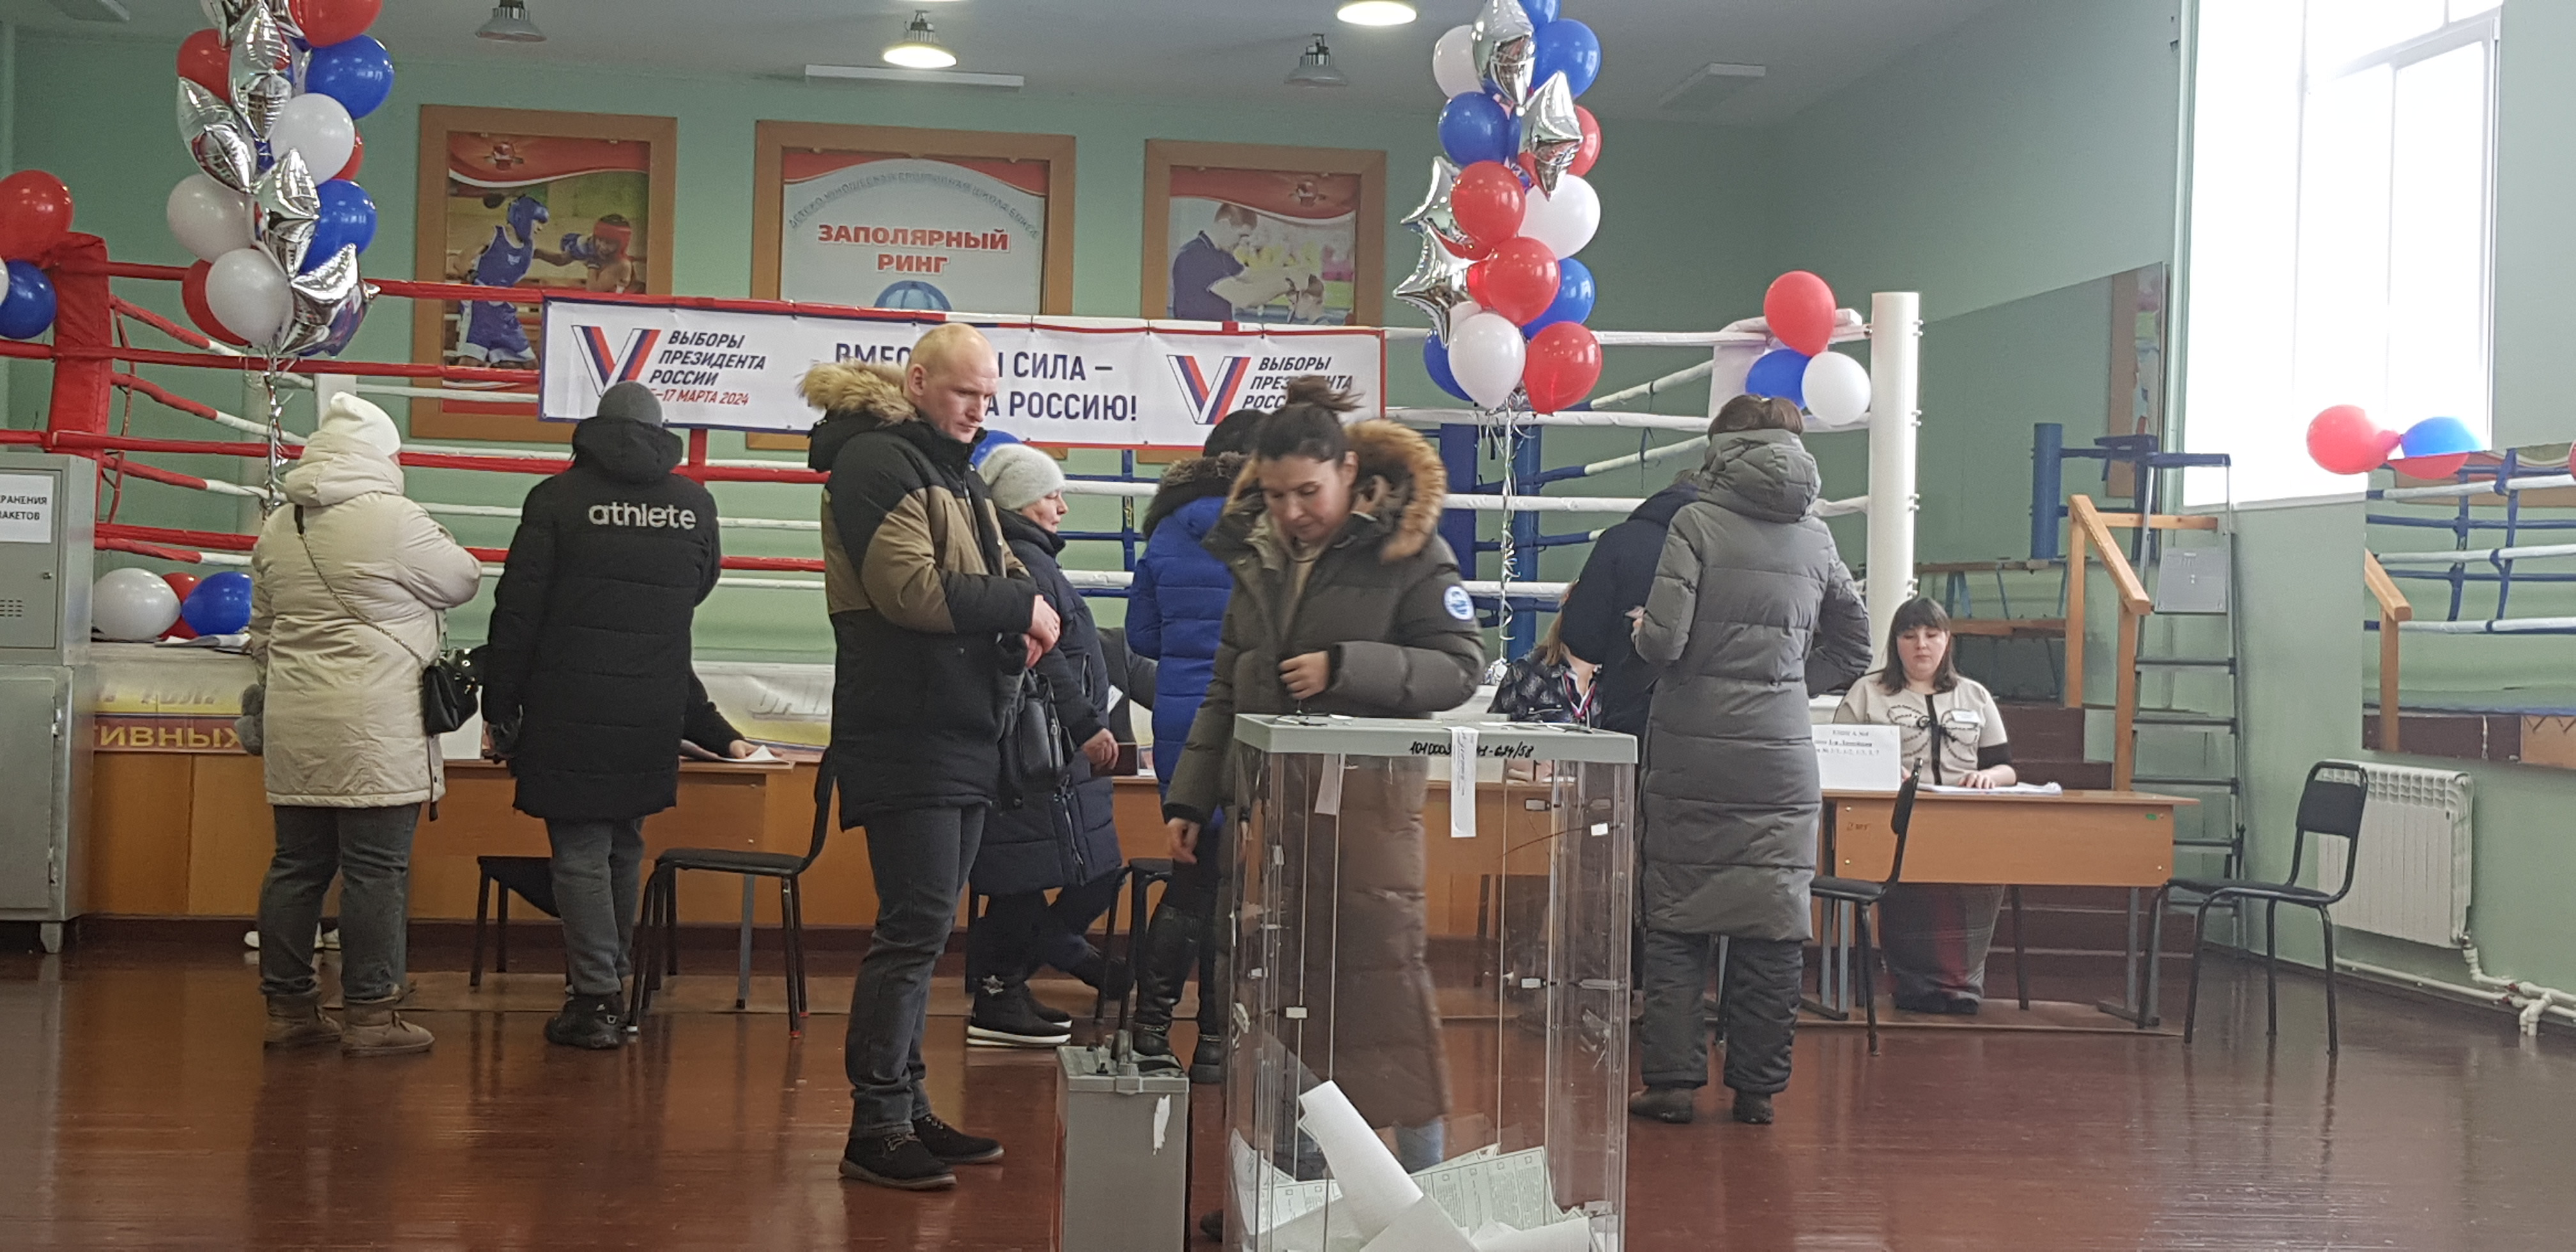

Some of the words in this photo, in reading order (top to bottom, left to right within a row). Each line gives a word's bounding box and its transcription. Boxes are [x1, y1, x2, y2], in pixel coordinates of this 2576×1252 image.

[818, 224, 1009, 250] ЗАПОЛЯРНЫЙ
[877, 253, 948, 273] РИНГ
[668, 330, 746, 349] ВЫБОРЫ
[658, 350, 767, 370] ПРЕЗИДЕНТА
[1013, 351, 1087, 381] СИЛА
[1258, 356, 1332, 371] ВЫБОРЫ
[648, 369, 719, 386] РОССИИ
[677, 389, 721, 404] МАРТА
[719, 392, 749, 405] 2024
[985, 394, 1000, 416] А
[1009, 391, 1137, 422] РОССИЮ!
[1241, 394, 1287, 409] РОСС
[0, 494, 47, 505] РАНЕНИЯ
[588, 501, 697, 530] athlete
[95, 725, 240, 749] ИВНЫХ
